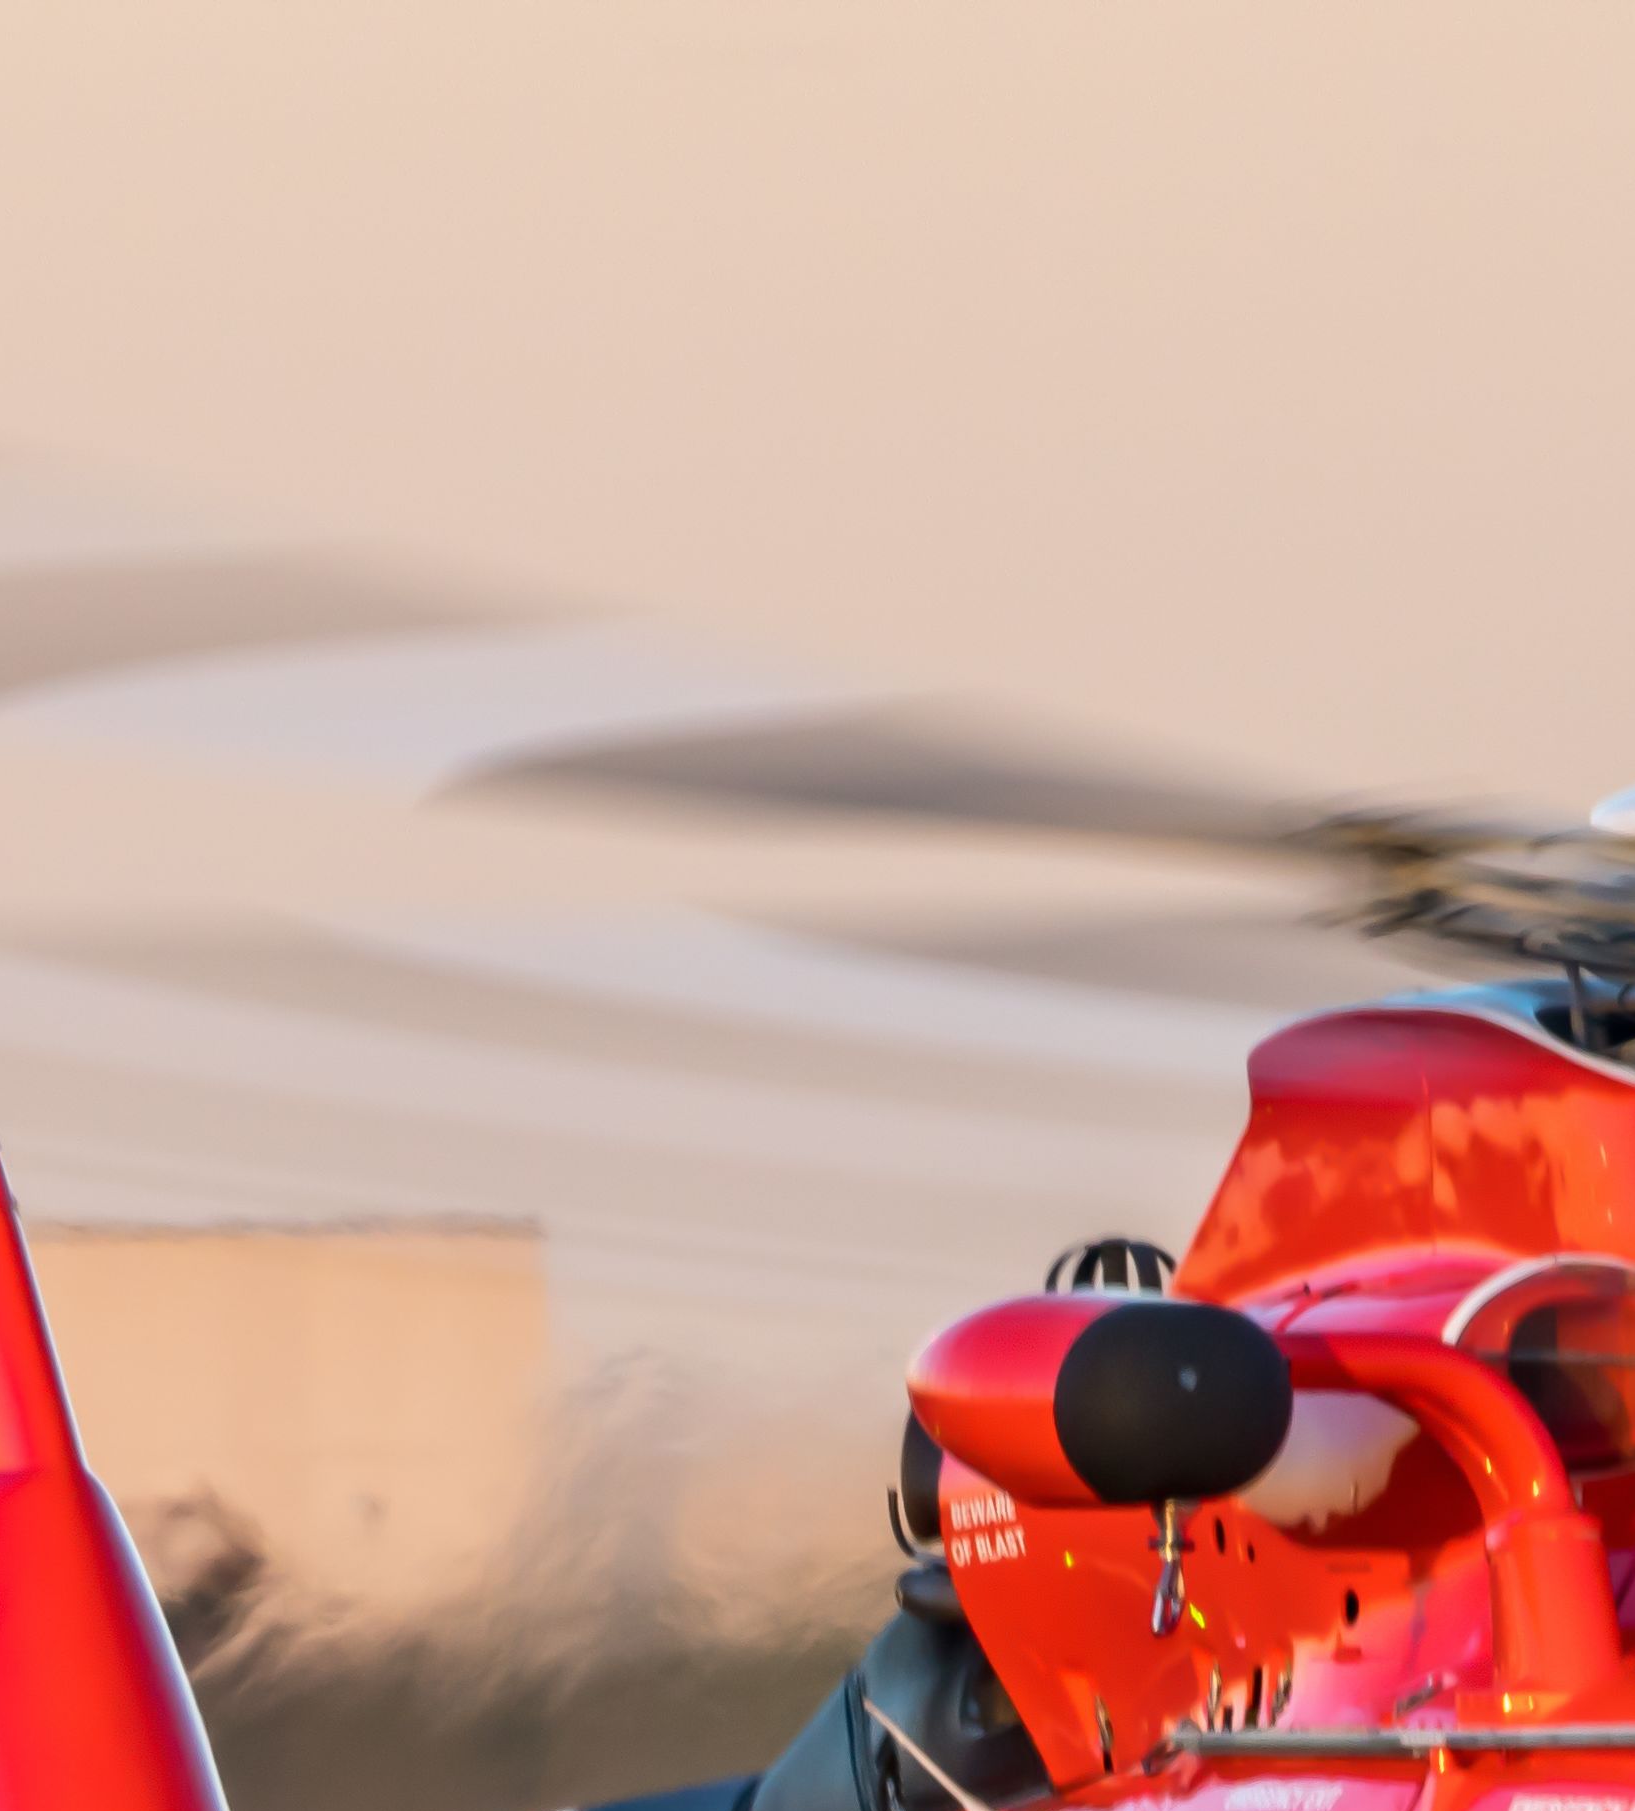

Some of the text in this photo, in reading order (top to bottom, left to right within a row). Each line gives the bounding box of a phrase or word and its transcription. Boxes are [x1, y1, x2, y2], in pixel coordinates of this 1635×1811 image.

[950, 1490, 1016, 1531] BEWARE
[951, 1526, 1027, 1568] OF BLAST
